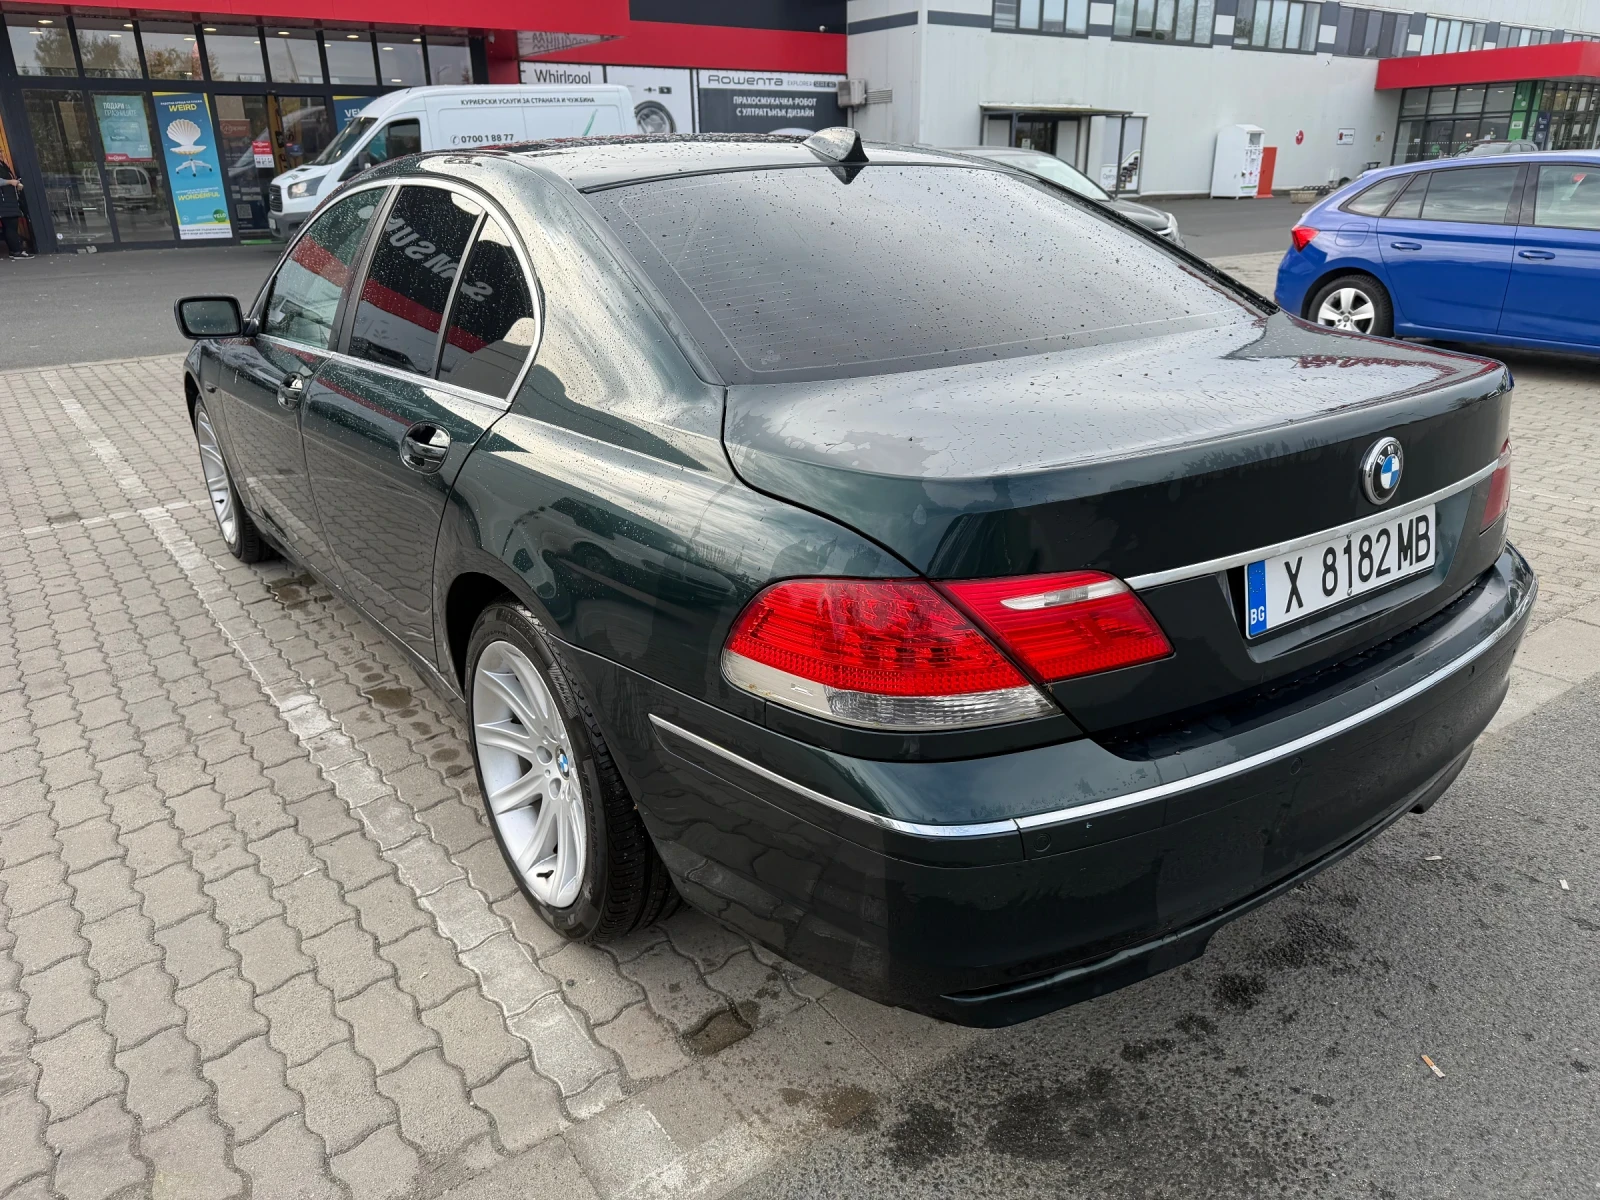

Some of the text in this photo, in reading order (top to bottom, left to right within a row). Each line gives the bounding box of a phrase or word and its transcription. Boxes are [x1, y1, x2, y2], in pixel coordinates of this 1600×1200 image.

[534, 69, 591, 84] Whirlpool
[708, 74, 783, 86] Rowenta
[461, 97, 498, 105] КУРИЕРСКИ
[499, 97, 521, 105] УСЛУГИ
[168, 104, 197, 112] WEIRD
[344, 108, 360, 118] VE
[736, 108, 815, 118] С УЛТРАТЪНЪК ДИЗАЙН
[461, 135, 483, 143] 0700
[491, 134, 502, 142] 88
[177, 191, 221, 201] WONDERFUL
[1321, 528, 1392, 597] 8182
[1397, 514, 1431, 571] MB
[1250, 606, 1266, 625] BG
